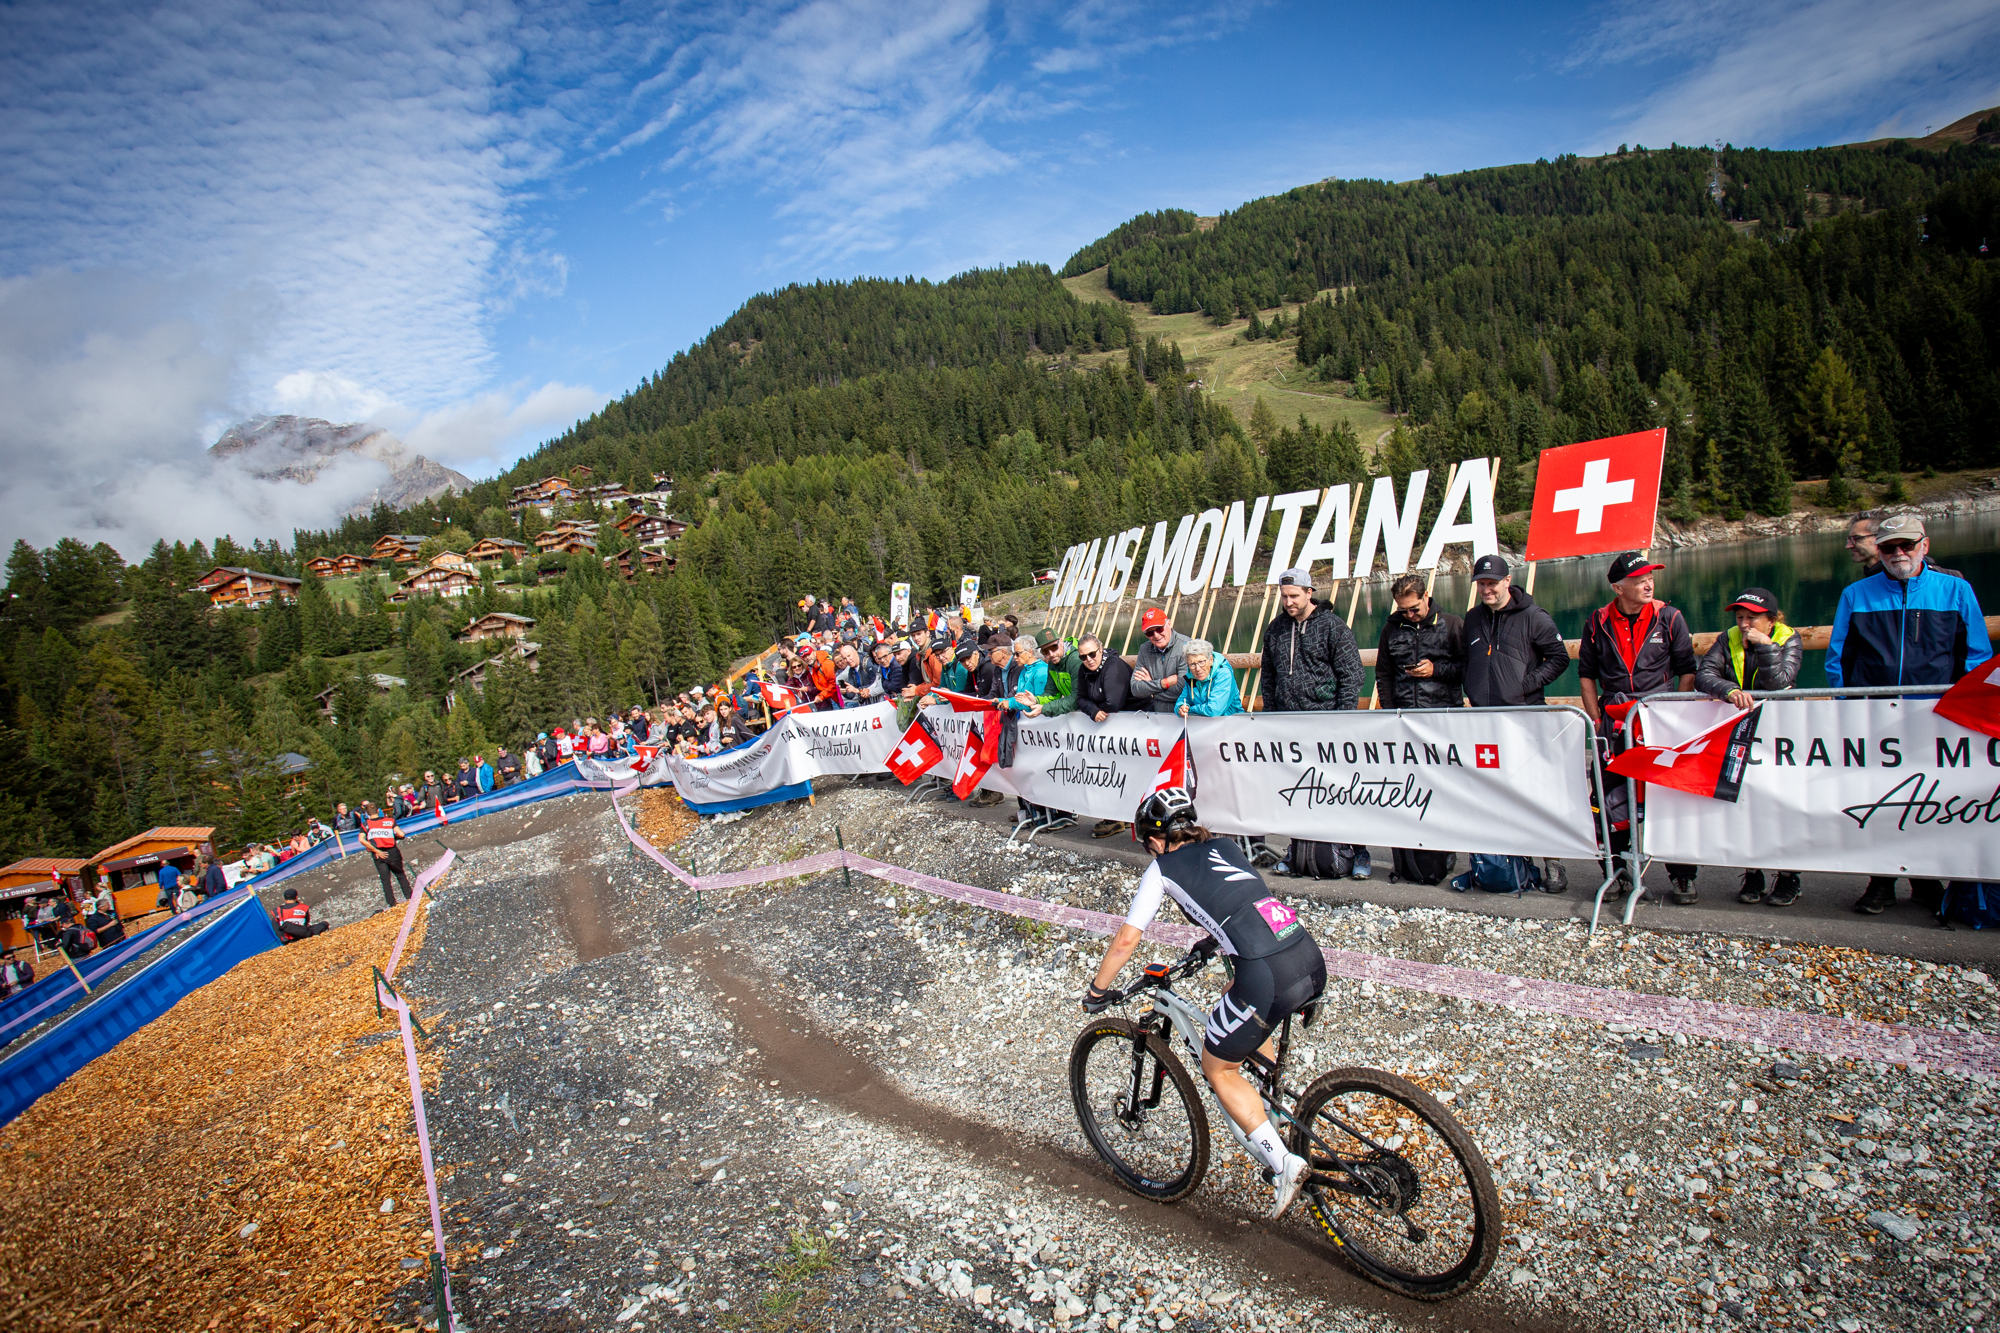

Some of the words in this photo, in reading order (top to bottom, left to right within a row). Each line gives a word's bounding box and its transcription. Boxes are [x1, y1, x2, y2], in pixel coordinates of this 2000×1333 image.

[1050, 527, 1143, 609] CRANS
[1135, 457, 1498, 600] MONTANA
[811, 719, 868, 738] MONTANA
[1020, 729, 1060, 749] CRANS
[1066, 732, 1142, 757] MONTANA
[1219, 741, 1303, 763] CRANS
[1316, 741, 1463, 767] MONTANA
[1748, 737, 1902, 767] CRANS
[1047, 752, 1127, 799] Absolutely
[1277, 766, 1433, 821] Absolutely
[135, 856, 159, 865] DRINKS
[11, 887, 37, 896] DRINKS
[1185, 902, 1198, 915] NEW
[1198, 913, 1224, 941] ZEALAND
[1271, 905, 1291, 923] 41
[1206, 992, 1257, 1046] NZL
[1311, 1204, 1345, 1248] MAXXI
